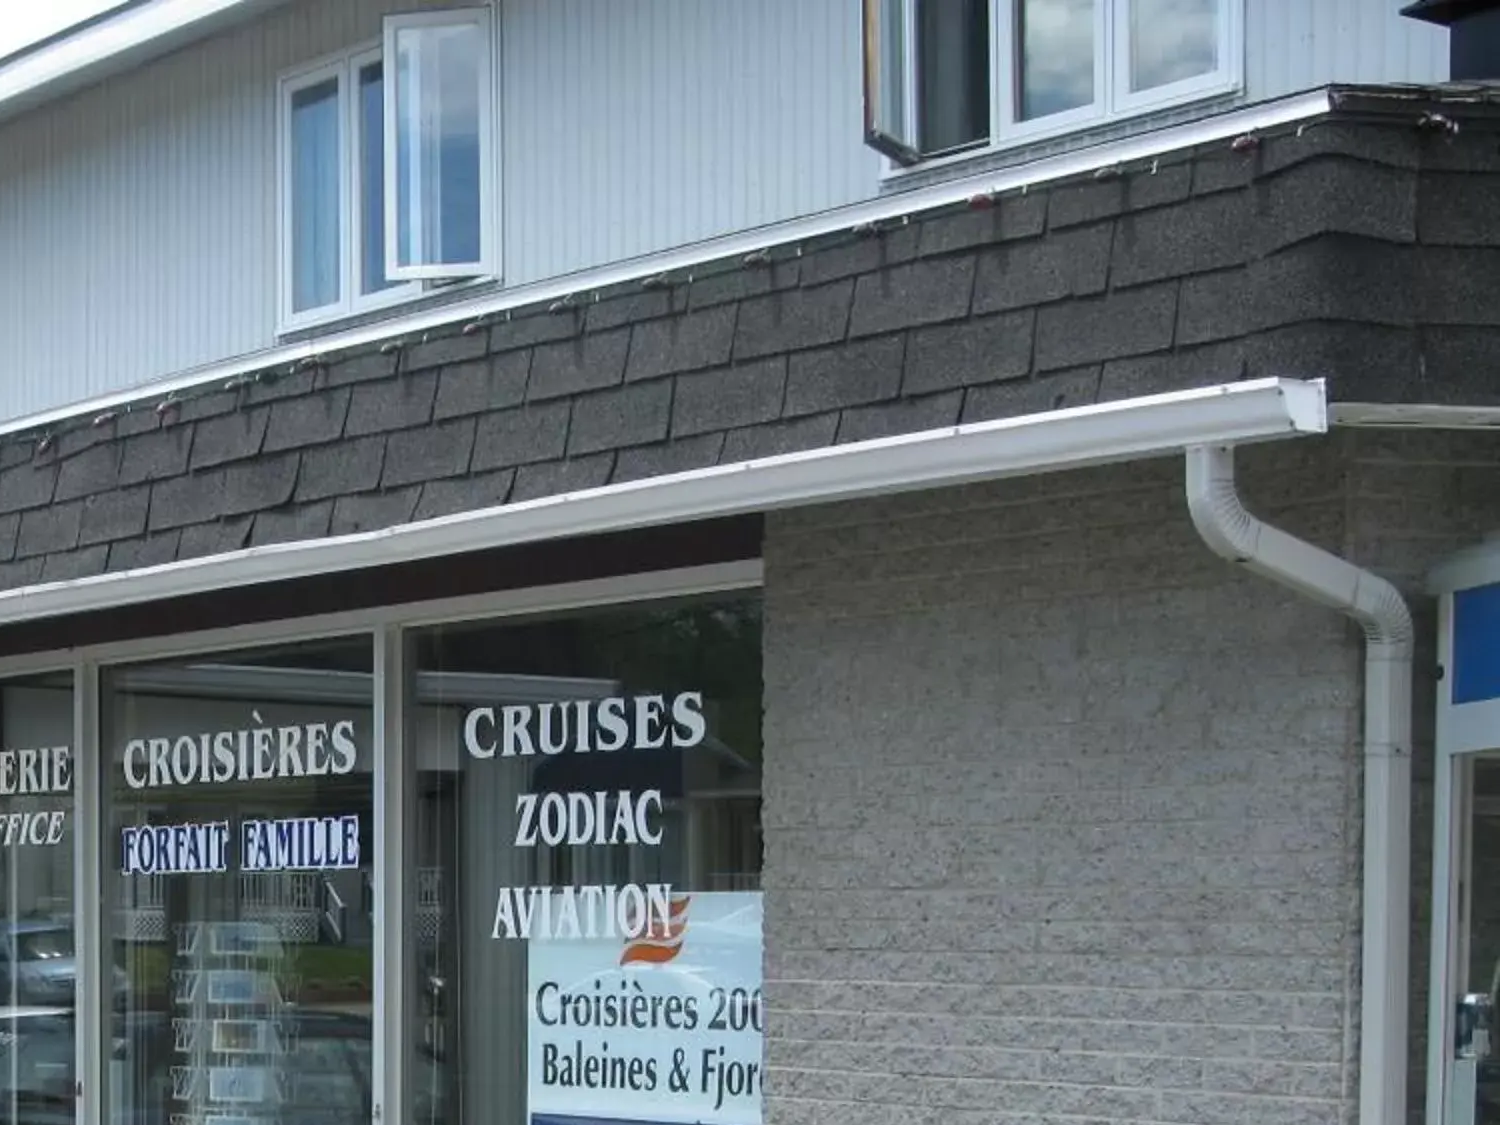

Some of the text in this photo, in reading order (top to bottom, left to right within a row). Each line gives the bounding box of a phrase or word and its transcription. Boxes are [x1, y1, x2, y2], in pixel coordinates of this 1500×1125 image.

[122, 710, 357, 790] CROISIÈRES
[464, 691, 706, 759] CRUISES
[120, 815, 360, 876] FORFAIT FAMILLE
[514, 789, 663, 847] ZODIAC
[491, 883, 672, 940] AVIATION
[535, 979, 699, 1031] Croisières
[542, 1039, 763, 1110] Baleines & Fjor
